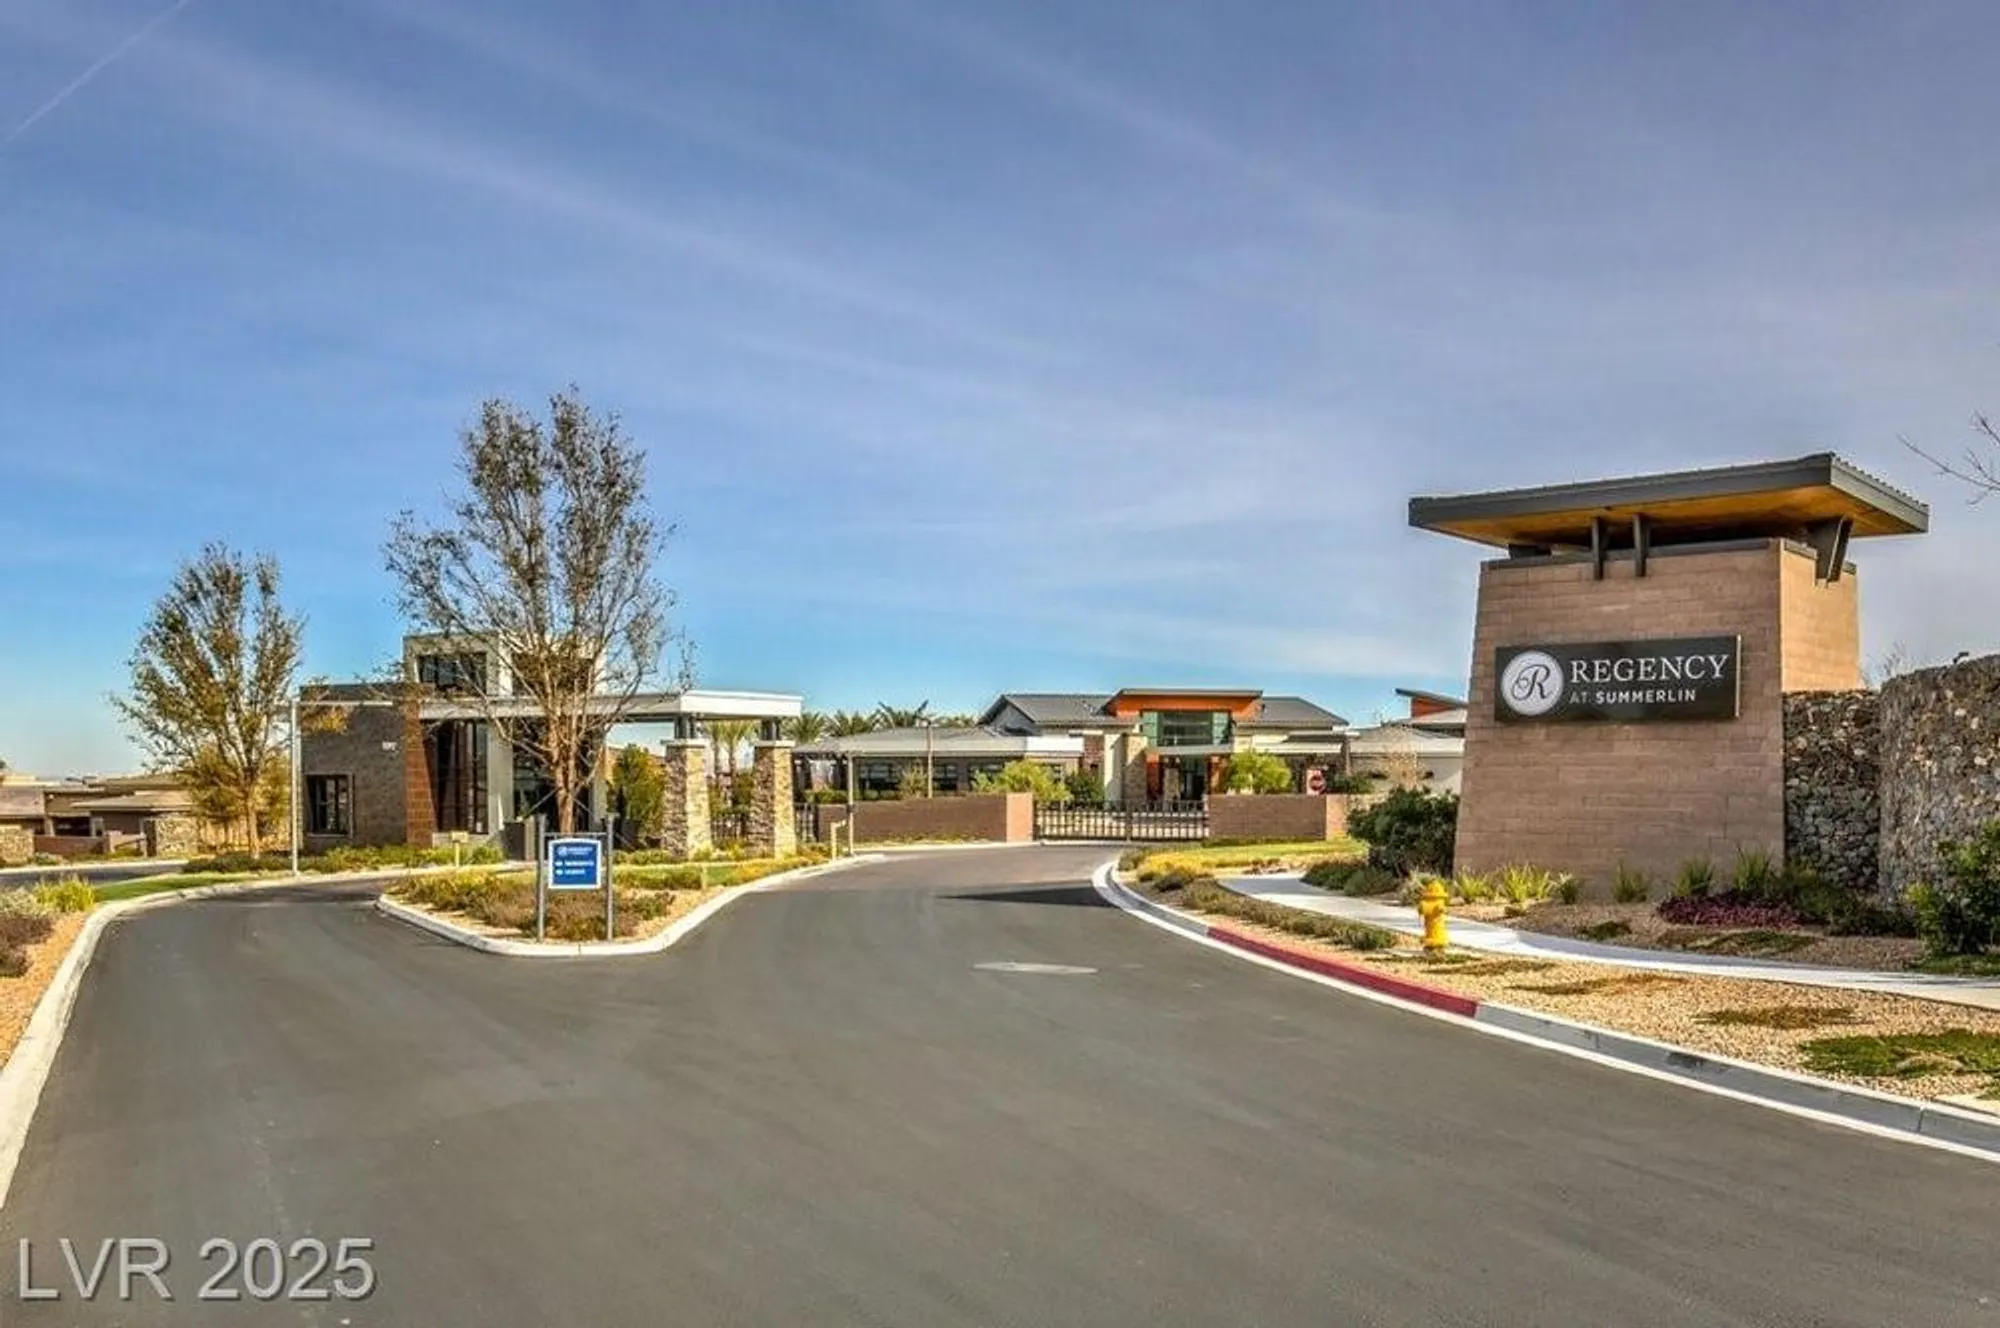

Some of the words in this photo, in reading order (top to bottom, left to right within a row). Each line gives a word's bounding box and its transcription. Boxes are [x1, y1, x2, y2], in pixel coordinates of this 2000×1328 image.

[1570, 654, 1729, 684] REGENCY
[1569, 691, 1588, 704] AT
[1595, 689, 1697, 705] SUMMERLIN
